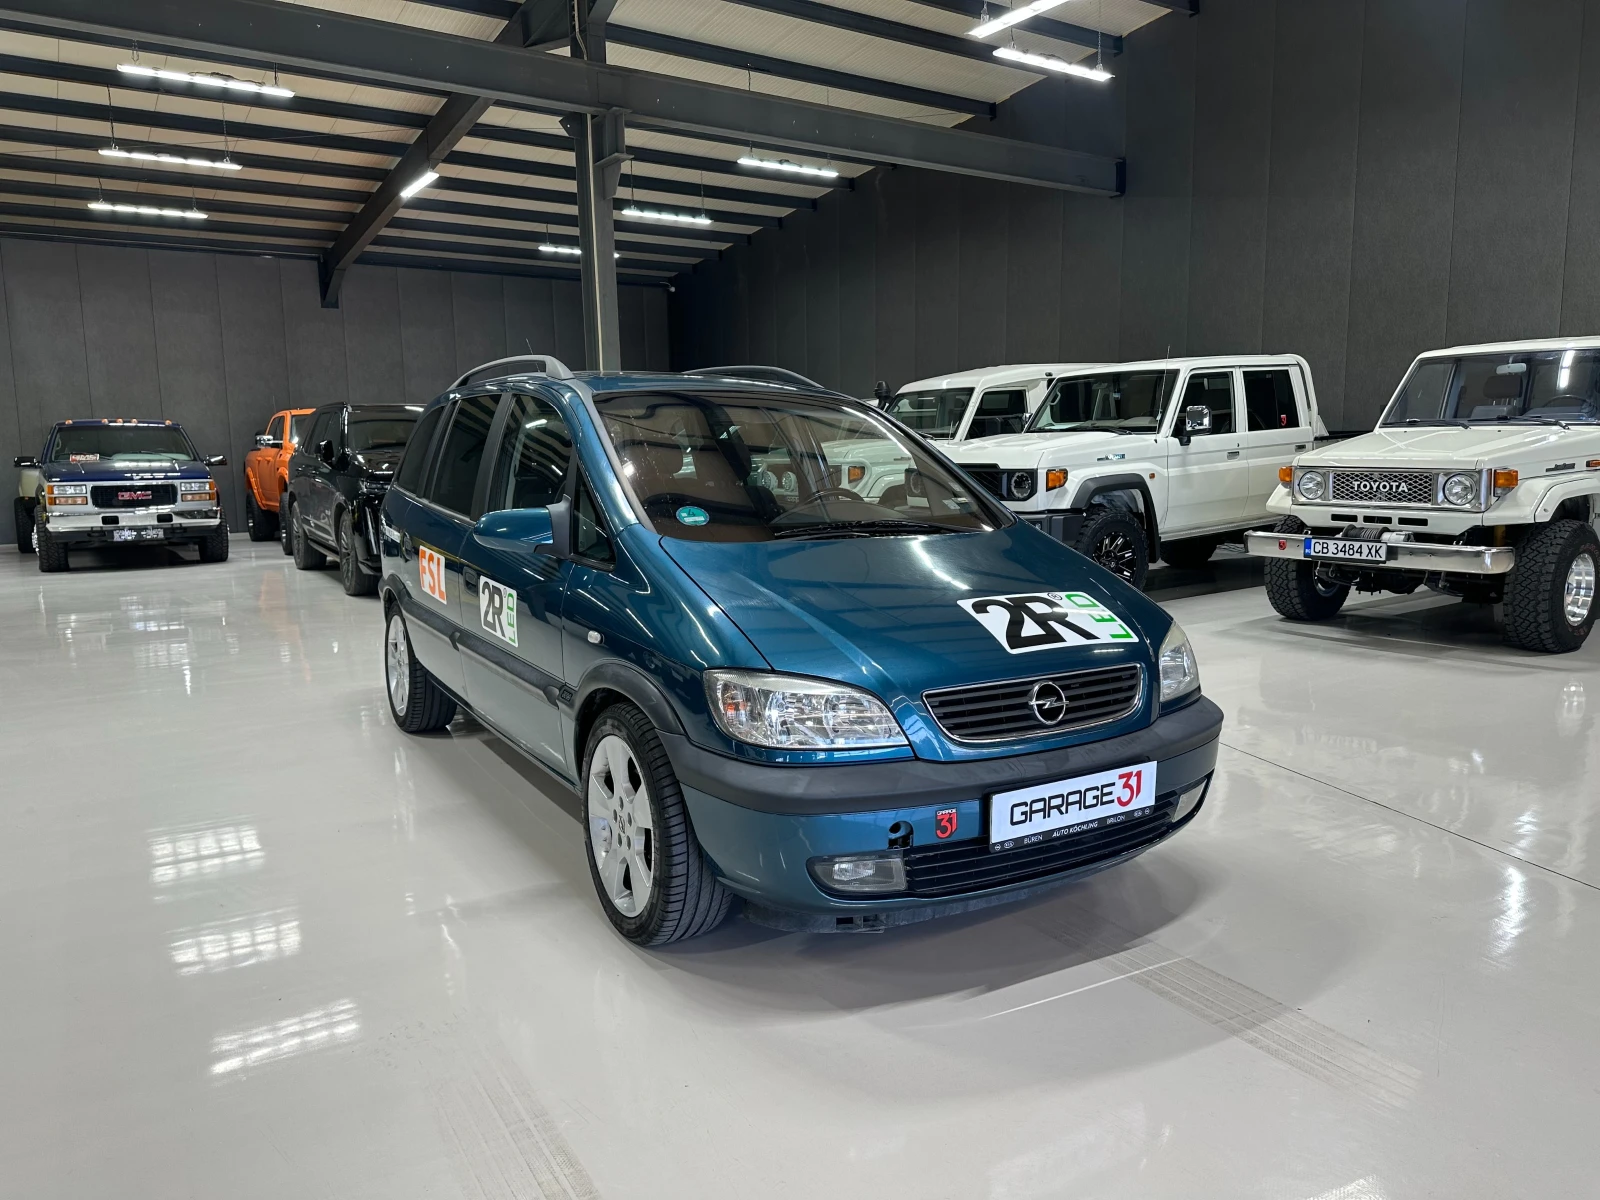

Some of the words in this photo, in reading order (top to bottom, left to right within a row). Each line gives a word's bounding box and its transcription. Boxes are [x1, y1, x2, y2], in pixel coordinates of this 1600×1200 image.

[118, 491, 152, 500] GMC
[1352, 481, 1409, 492] TOYOTA
[1313, 541, 1330, 555] CB
[1331, 542, 1363, 557] 3484
[1366, 544, 1383, 559] XK
[419, 549, 446, 601] FSL
[506, 592, 516, 644] LED
[1065, 593, 1134, 639] LED
[936, 808, 956, 816] GARAGE
[936, 812, 957, 839] 31
[1023, 834, 1043, 845] BÜREN
[1052, 828, 1069, 838] AUTO
[1069, 821, 1099, 833] KÖCHLING
[1106, 814, 1126, 825] BRILON
